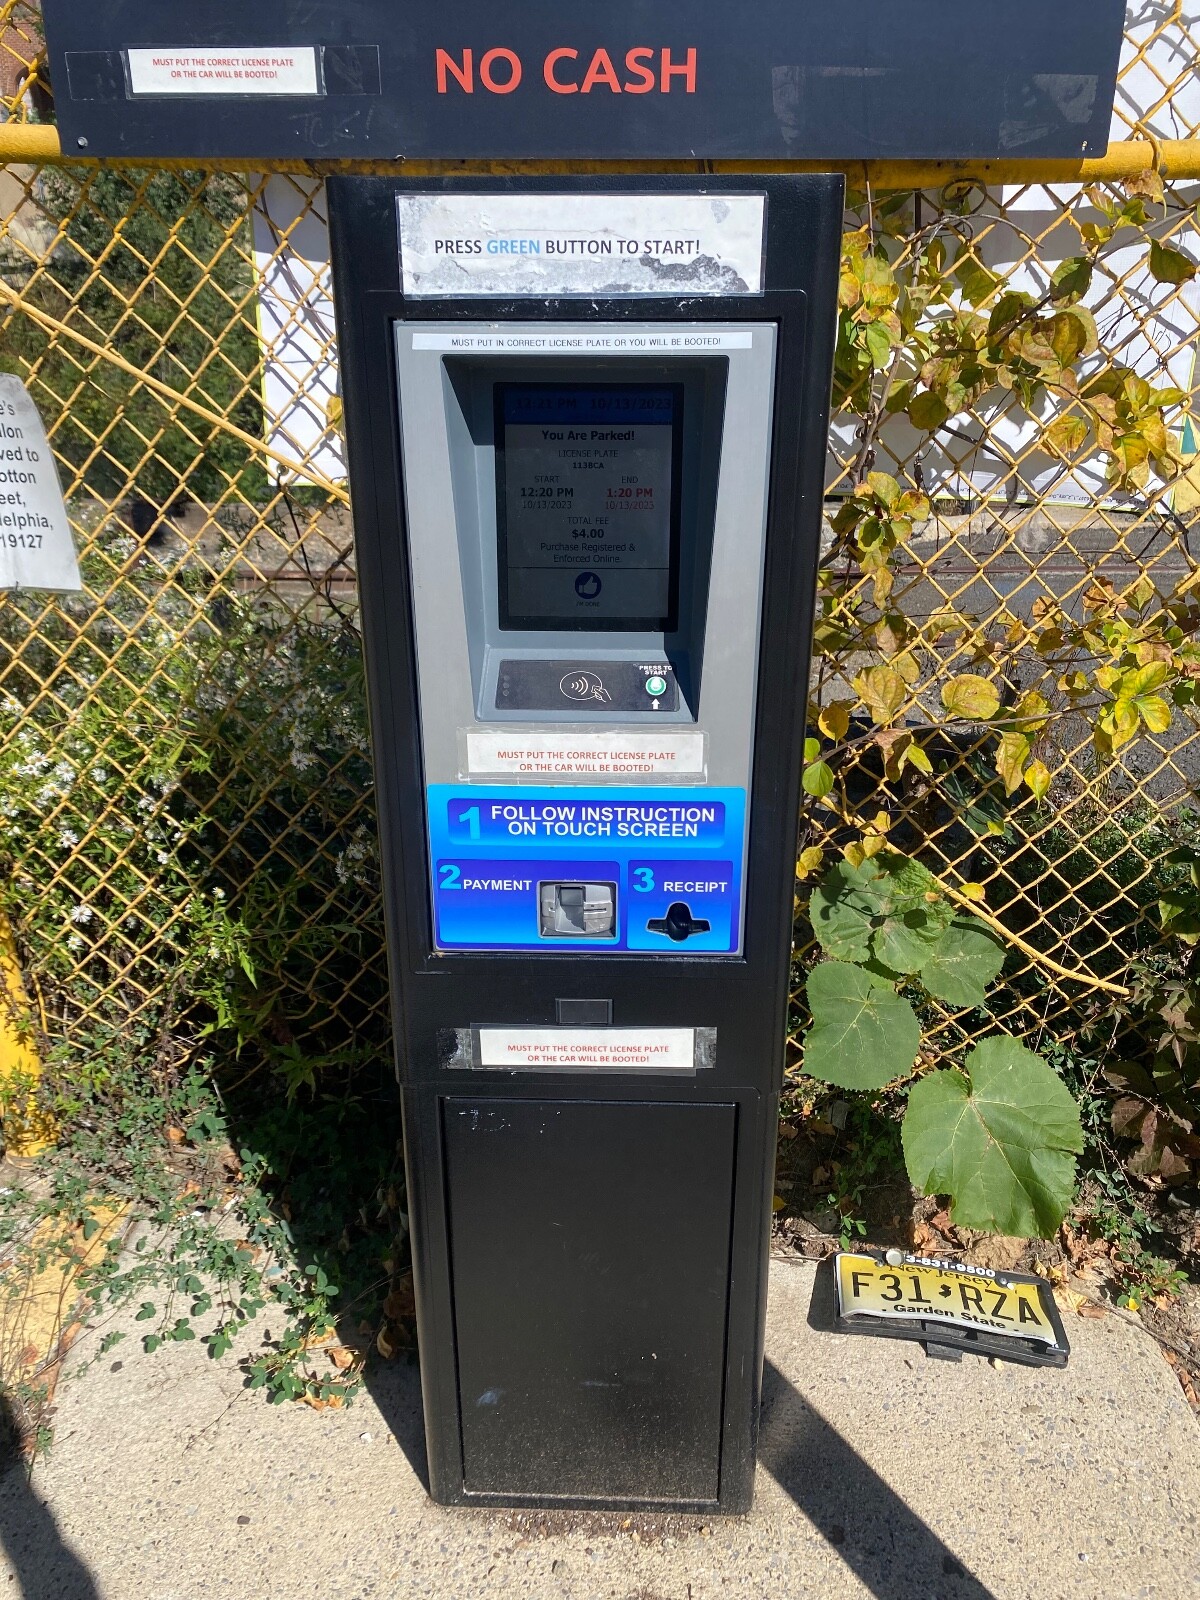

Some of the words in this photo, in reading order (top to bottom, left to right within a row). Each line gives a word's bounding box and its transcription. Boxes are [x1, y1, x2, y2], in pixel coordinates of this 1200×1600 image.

[152, 58, 174, 66] MUST
[176, 58, 190, 66] PUT
[191, 58, 205, 66] THE
[207, 58, 240, 66] CORRECT
[241, 58, 270, 66] LICENSE
[271, 59, 294, 67] PLATE
[170, 70, 182, 78] OR
[244, 71, 277, 79] BOOTED!
[435, 47, 523, 94] NO
[543, 47, 697, 94] CASH
[434, 240, 482, 254] PRESS
[486, 240, 541, 254] GREEN
[546, 240, 612, 254] BUTTON
[616, 240, 638, 254] TO
[644, 240, 700, 254] START!
[451, 339, 474, 347] MUST
[586, 338, 611, 346] PLATE
[614, 338, 627, 346] OR
[629, 338, 646, 346] YOU
[649, 338, 668, 346] WILL
[671, 338, 681, 346] BE
[684, 338, 721, 346] BOOTED!
[557, 397, 577, 409] PM
[590, 397, 671, 410] 10/13/2023
[0, 423, 23, 438] lon
[542, 430, 564, 441] You
[567, 430, 587, 441] Are
[591, 430, 635, 441] Parked!
[26, 448, 39, 462] to
[558, 449, 590, 458] LICENSE
[591, 449, 618, 458] PLATE
[0, 469, 36, 484] otton
[534, 475, 559, 483] START
[520, 487, 553, 497] 12:20
[557, 487, 574, 497] PM
[607, 488, 632, 497] 1:20
[636, 488, 653, 497] PM
[0, 491, 25, 507] eet,
[522, 500, 572, 510] 10/13/2023
[605, 501, 654, 510] 10/13/2023
[0, 512, 53, 530] elphia,
[568, 516, 592, 524] TOTAL
[572, 528, 604, 539] $4.00
[0, 533, 43, 549] 19127
[540, 543, 578, 551] Purchase
[582, 543, 626, 553] Registered
[629, 543, 636, 551] &
[553, 555, 590, 563] Enforced
[497, 751, 525, 759] MUST
[526, 751, 545, 759] PUT
[546, 751, 564, 759] THE
[566, 751, 608, 759] CORRECT
[610, 752, 646, 760] LICENSE
[648, 752, 676, 760] PLATE
[575, 764, 597, 772] WILL
[599, 764, 611, 772] BE
[612, 764, 654, 772] BOOTED!
[491, 805, 576, 821] FOLLOW
[581, 807, 715, 822] INSTRUCTION
[458, 806, 481, 840] 1
[508, 822, 536, 836] ON
[542, 822, 611, 836] TOUCH
[617, 822, 698, 837] SCREEN
[438, 864, 462, 890] 2
[463, 879, 532, 891] PAYMENT
[632, 867, 656, 892] 3
[663, 881, 728, 893] RECEIPT
[936, 1269, 993, 1288] Jersey
[852, 1271, 932, 1303] F31
[958, 1282, 1042, 1326] RZA
[893, 1304, 955, 1318] Garden
[960, 1312, 1006, 1329] State
